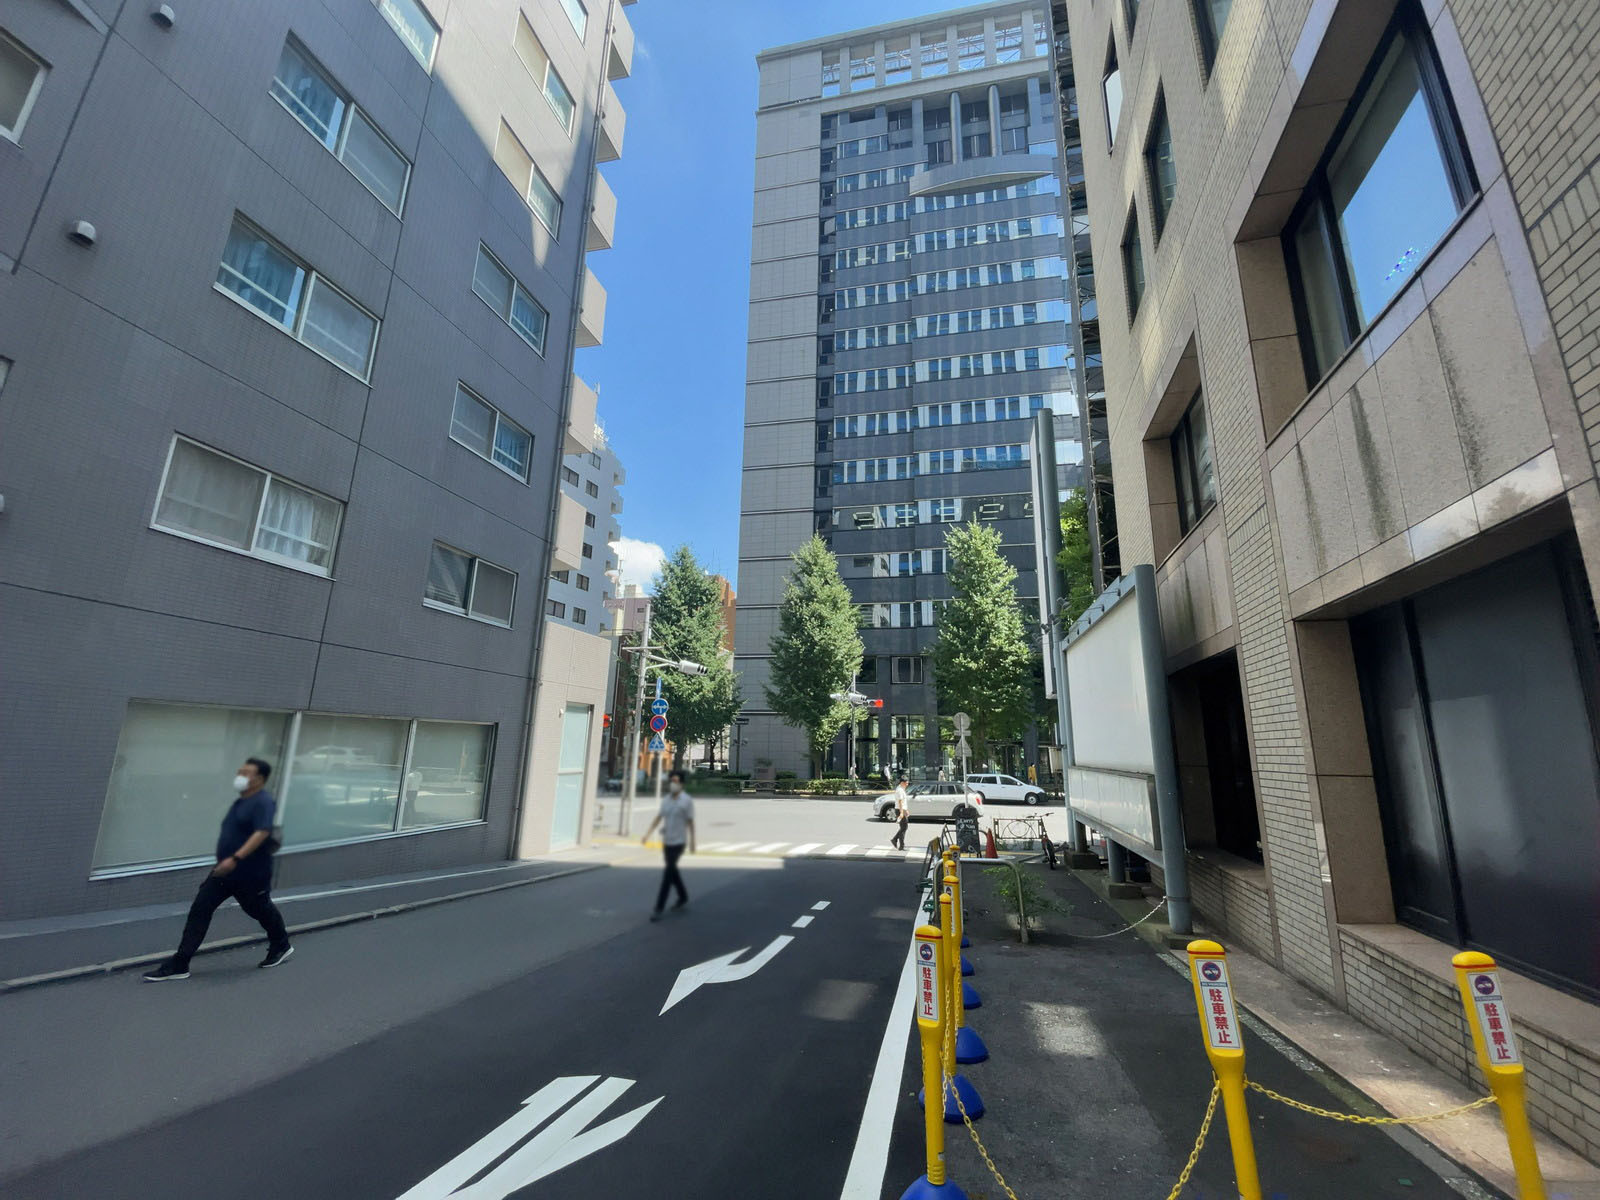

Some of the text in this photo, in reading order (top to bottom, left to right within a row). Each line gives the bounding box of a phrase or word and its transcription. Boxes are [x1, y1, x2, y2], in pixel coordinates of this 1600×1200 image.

[922, 967, 933, 1015] 駐車禁止
[1209, 988, 1232, 1044] 駐車禁止
[1484, 1003, 1511, 1059] 駐車禁止
